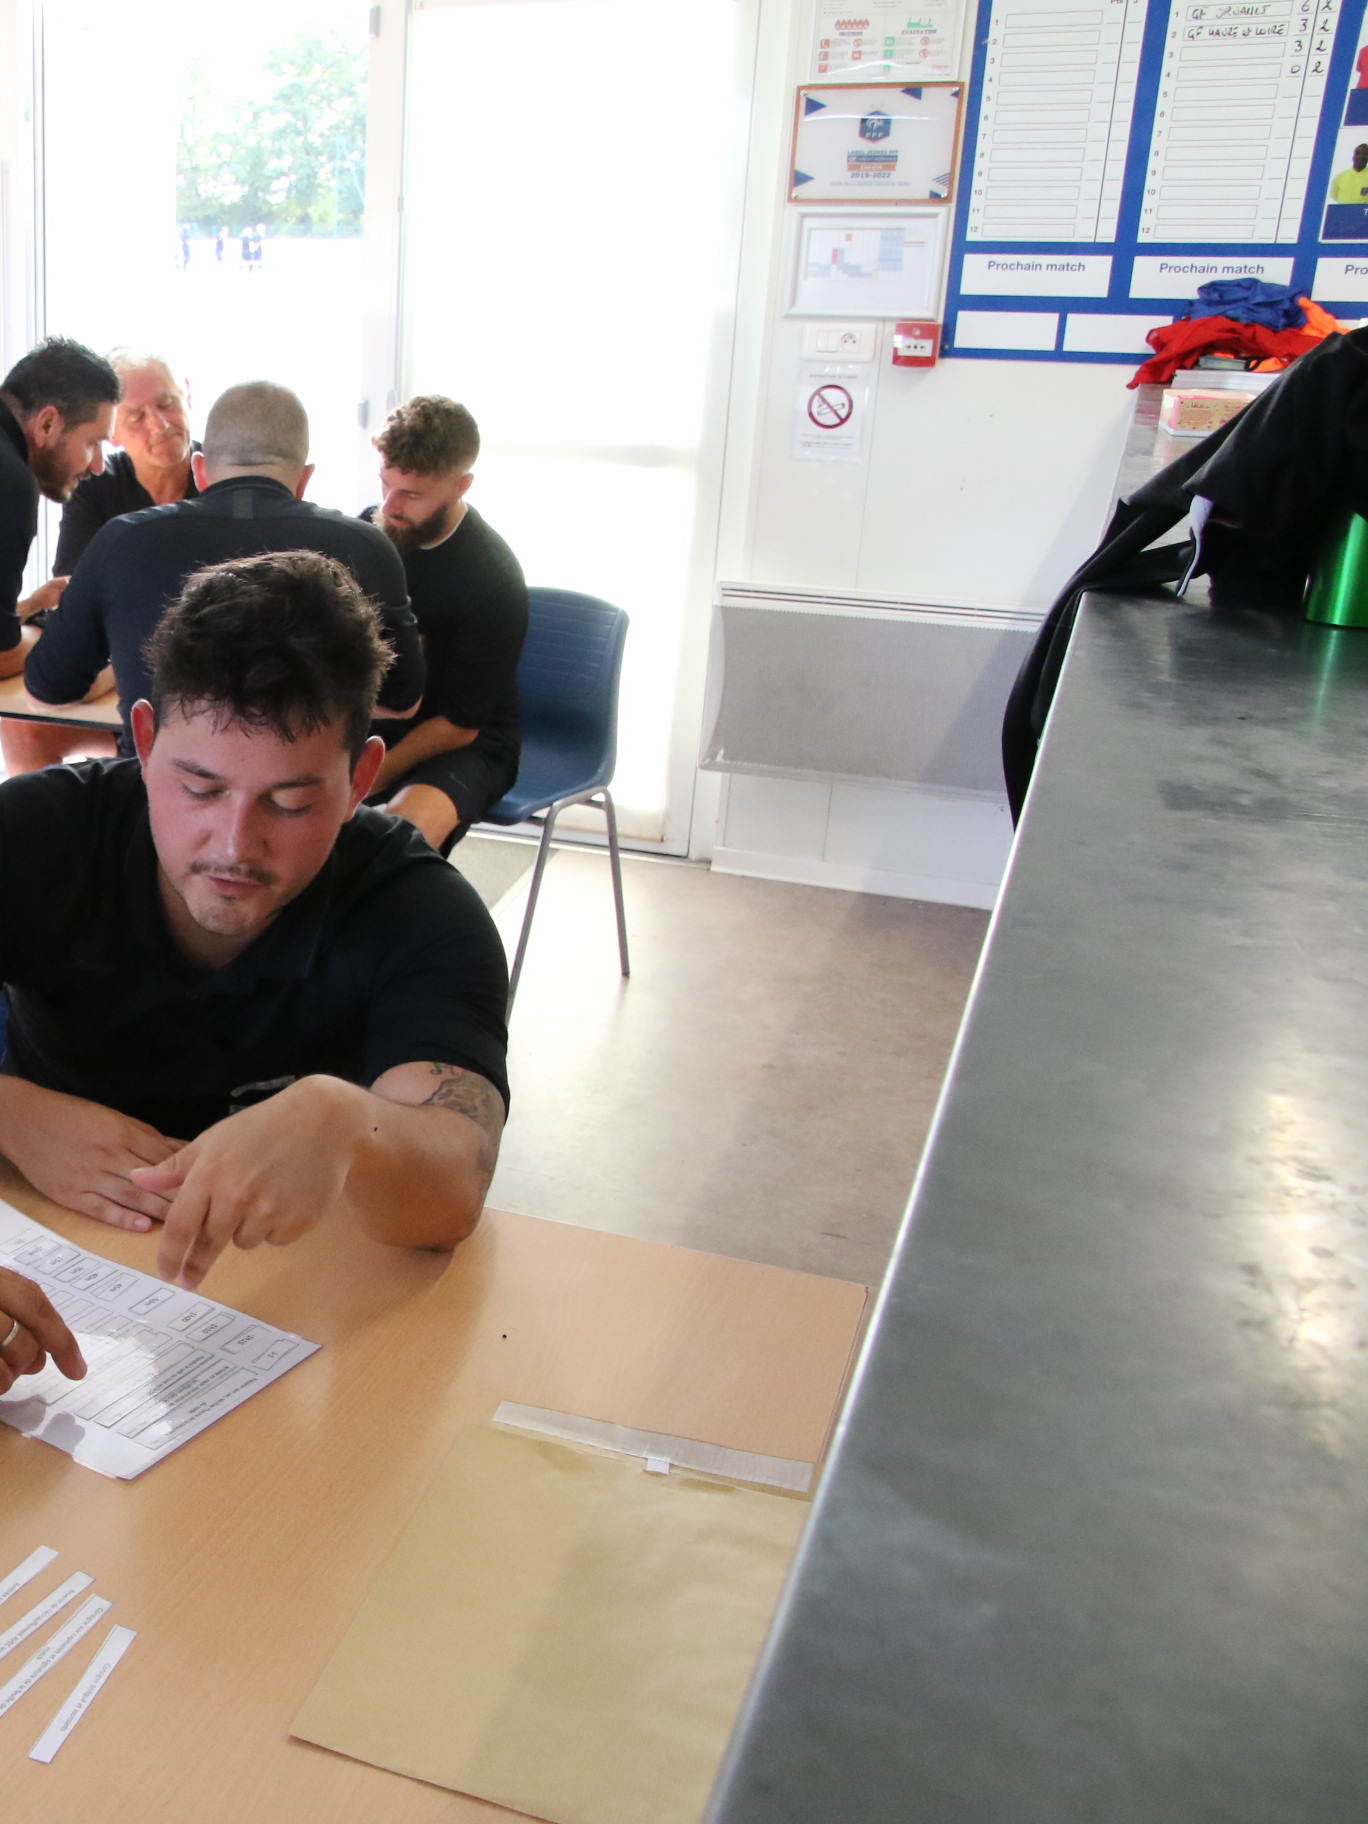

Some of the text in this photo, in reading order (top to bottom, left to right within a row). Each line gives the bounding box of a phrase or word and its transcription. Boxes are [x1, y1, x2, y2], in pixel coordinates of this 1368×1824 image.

[1299, 18, 1308, 32] 3
[1187, 26, 1203, 40] GF
[1295, 40, 1303, 52] 3
[1312, 61, 1324, 74] 2
[1153, 149, 1159, 157] 8
[1151, 169, 1157, 177] 9
[987, 260, 1086, 272] Prochain match
[1159, 263, 1264, 275] Prochain match
[235, 1332, 258, 1346] -1h15
[4, 1635, 20, 1646] AVEC
[53, 1632, 77, 1654] capitaines
[28, 1658, 52, 1678] signature
[4, 1689, 22, 1703] feuille
